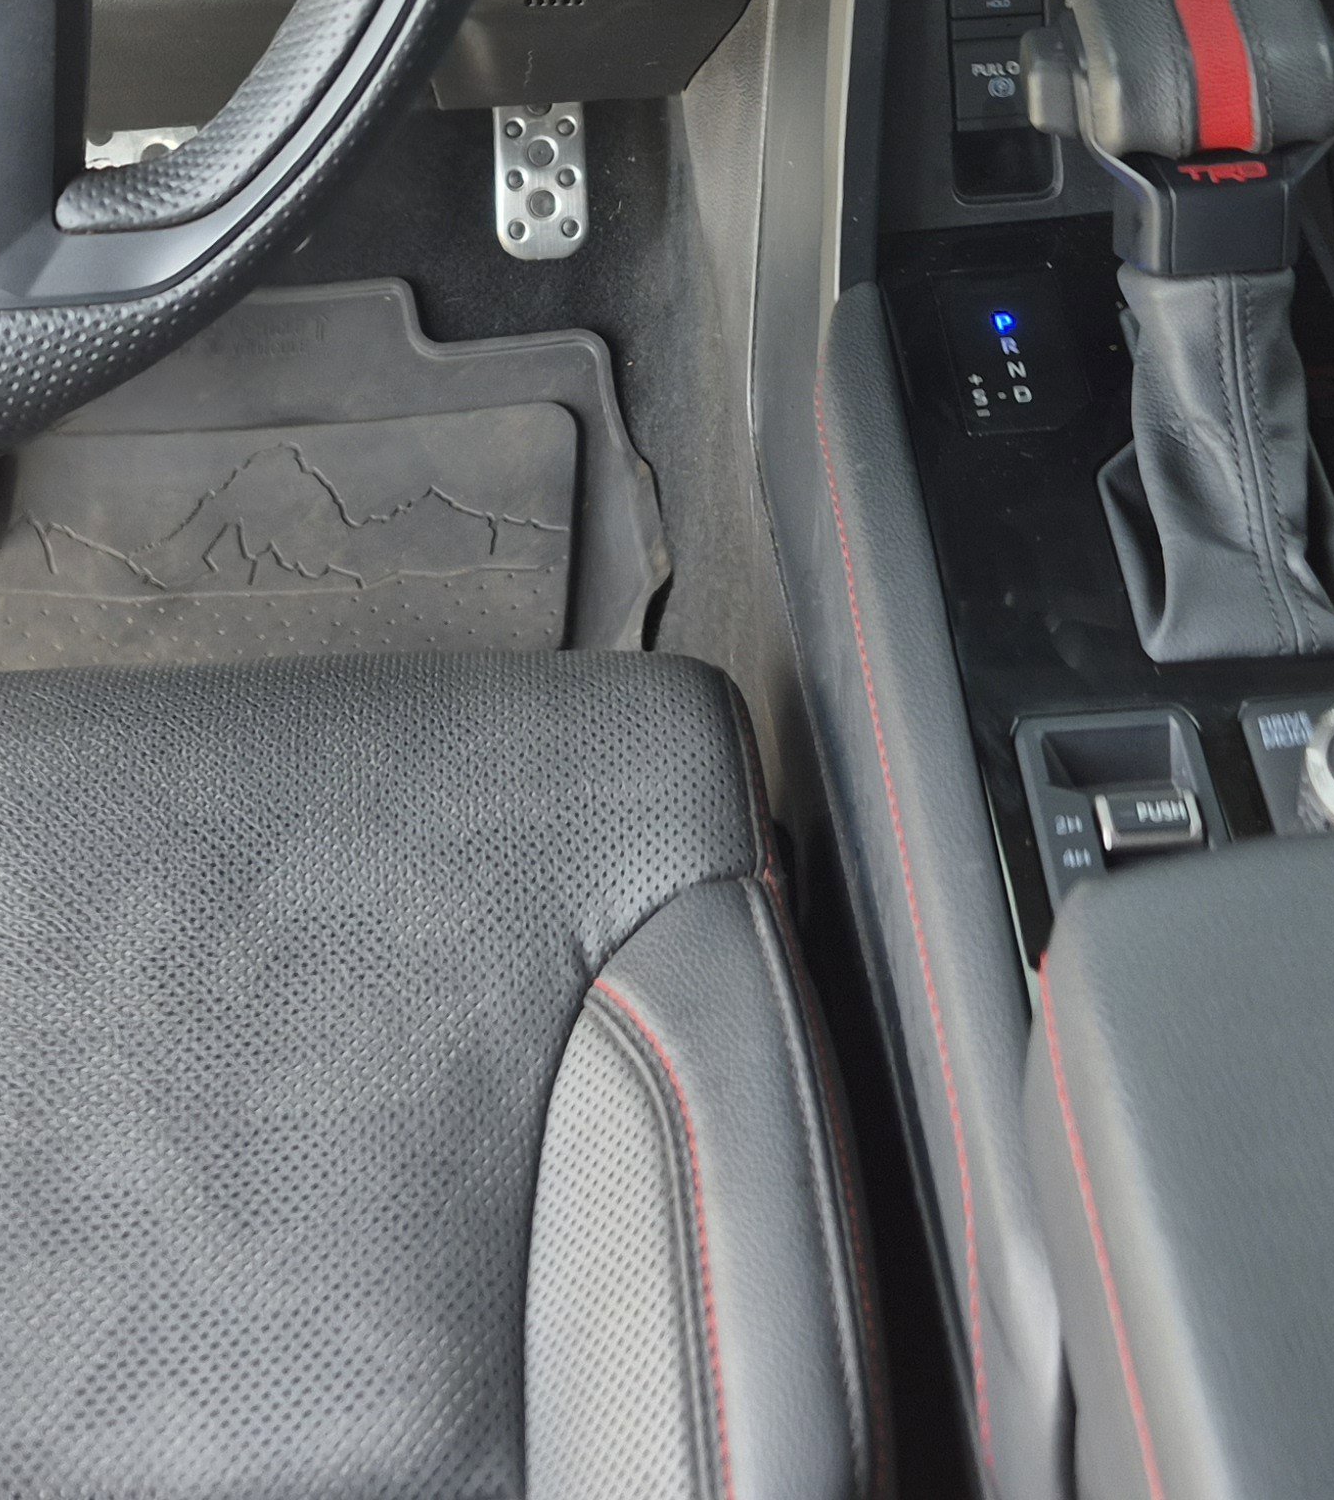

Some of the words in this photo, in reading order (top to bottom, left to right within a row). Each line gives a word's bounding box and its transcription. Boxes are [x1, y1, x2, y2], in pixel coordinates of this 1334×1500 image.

[993, 311, 1016, 334] P
[1000, 336, 1020, 356] R
[1007, 361, 1027, 379] N
[972, 388, 989, 407] S
[1013, 385, 1033, 403] D
